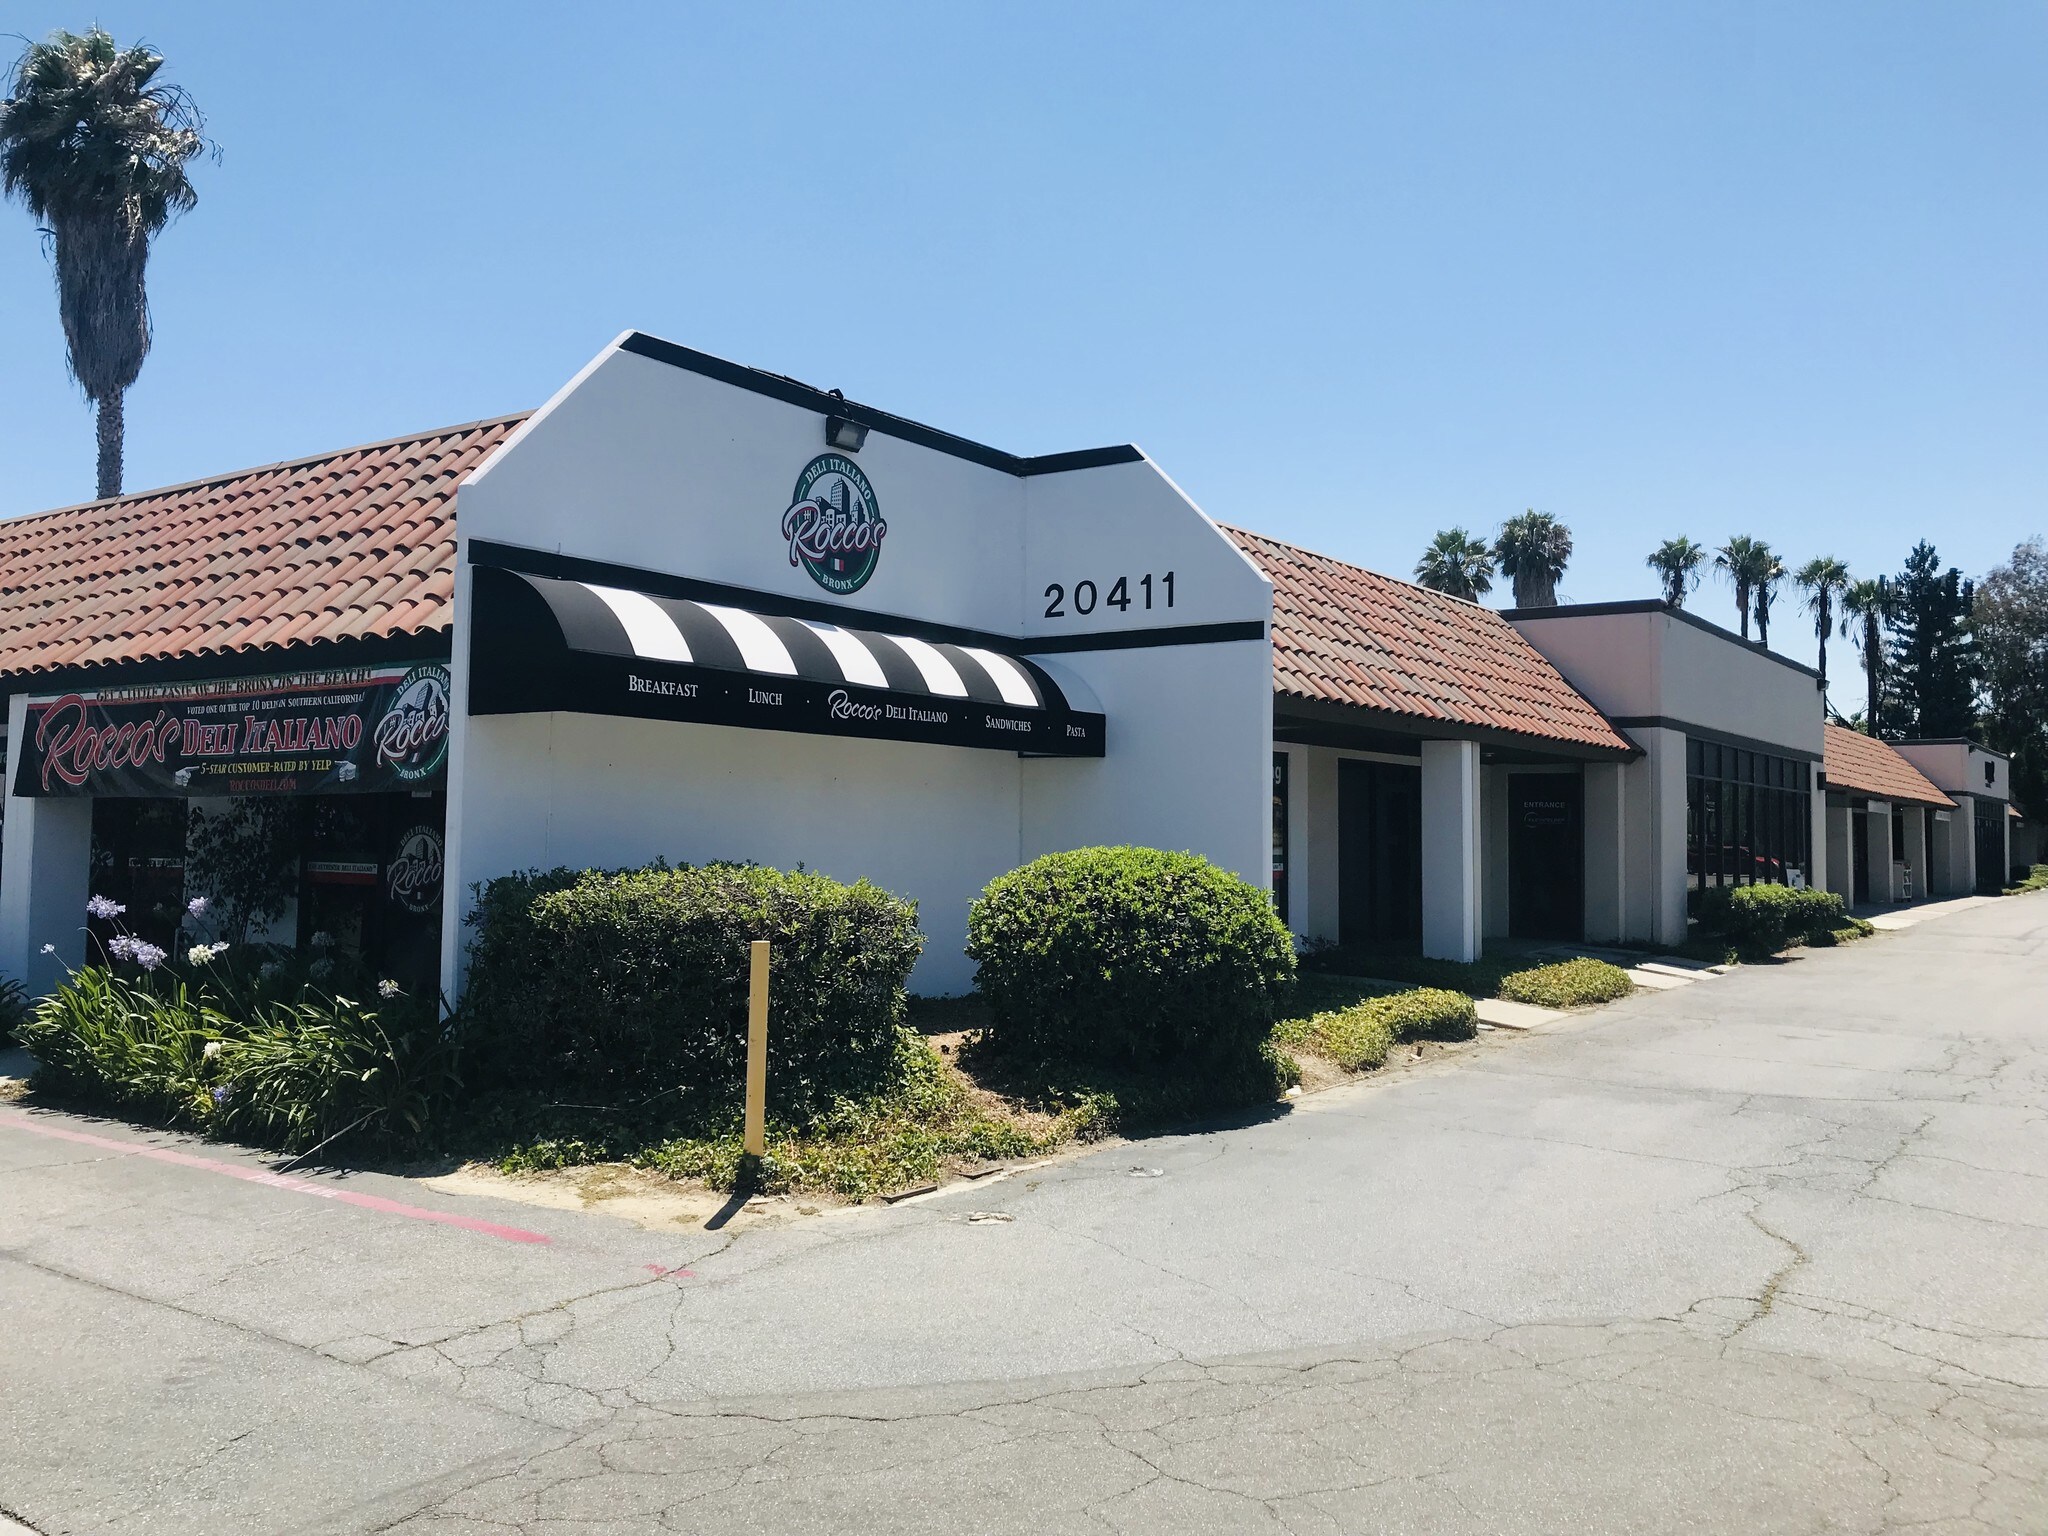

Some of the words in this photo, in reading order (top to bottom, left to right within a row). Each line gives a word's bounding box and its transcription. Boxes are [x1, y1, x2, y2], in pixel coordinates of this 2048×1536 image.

[805, 460, 827, 484] DELI
[829, 458, 872, 500] ITALIANO
[821, 573, 853, 590] BRONX
[1044, 571, 1174, 618] 20411
[161, 684, 192, 699] TASTE
[195, 682, 210, 698] OF
[213, 680, 232, 696] THE
[236, 677, 275, 694] BRONX
[278, 674, 295, 691] ON
[299, 671, 320, 688] THE
[324, 667, 372, 686] BEACH!
[396, 672, 417, 696] DELI
[187, 705, 205, 715] VOTED
[206, 704, 217, 713] ONE
[227, 703, 238, 712] THE
[239, 702, 249, 711] TOP
[252, 700, 260, 711] 10
[288, 696, 322, 708] SOUTHERN
[628, 674, 699, 697] BREAKFAST
[748, 688, 783, 706] LUNCH
[885, 704, 906, 720] DELI
[908, 707, 948, 723] ITALIANO
[985, 715, 1032, 732] SANDWICHES
[1066, 724, 1086, 738] PASTA
[181, 718, 238, 756] DELI
[240, 714, 363, 754] ITALIANO
[200, 762, 227, 775] 5-STAR
[227, 760, 296, 774] CUSTOMER-RATED
[299, 760, 310, 771] BY
[312, 759, 332, 771] YELP
[400, 767, 427, 780] BRONX
[1523, 801, 1566, 809] ENTRANCE
